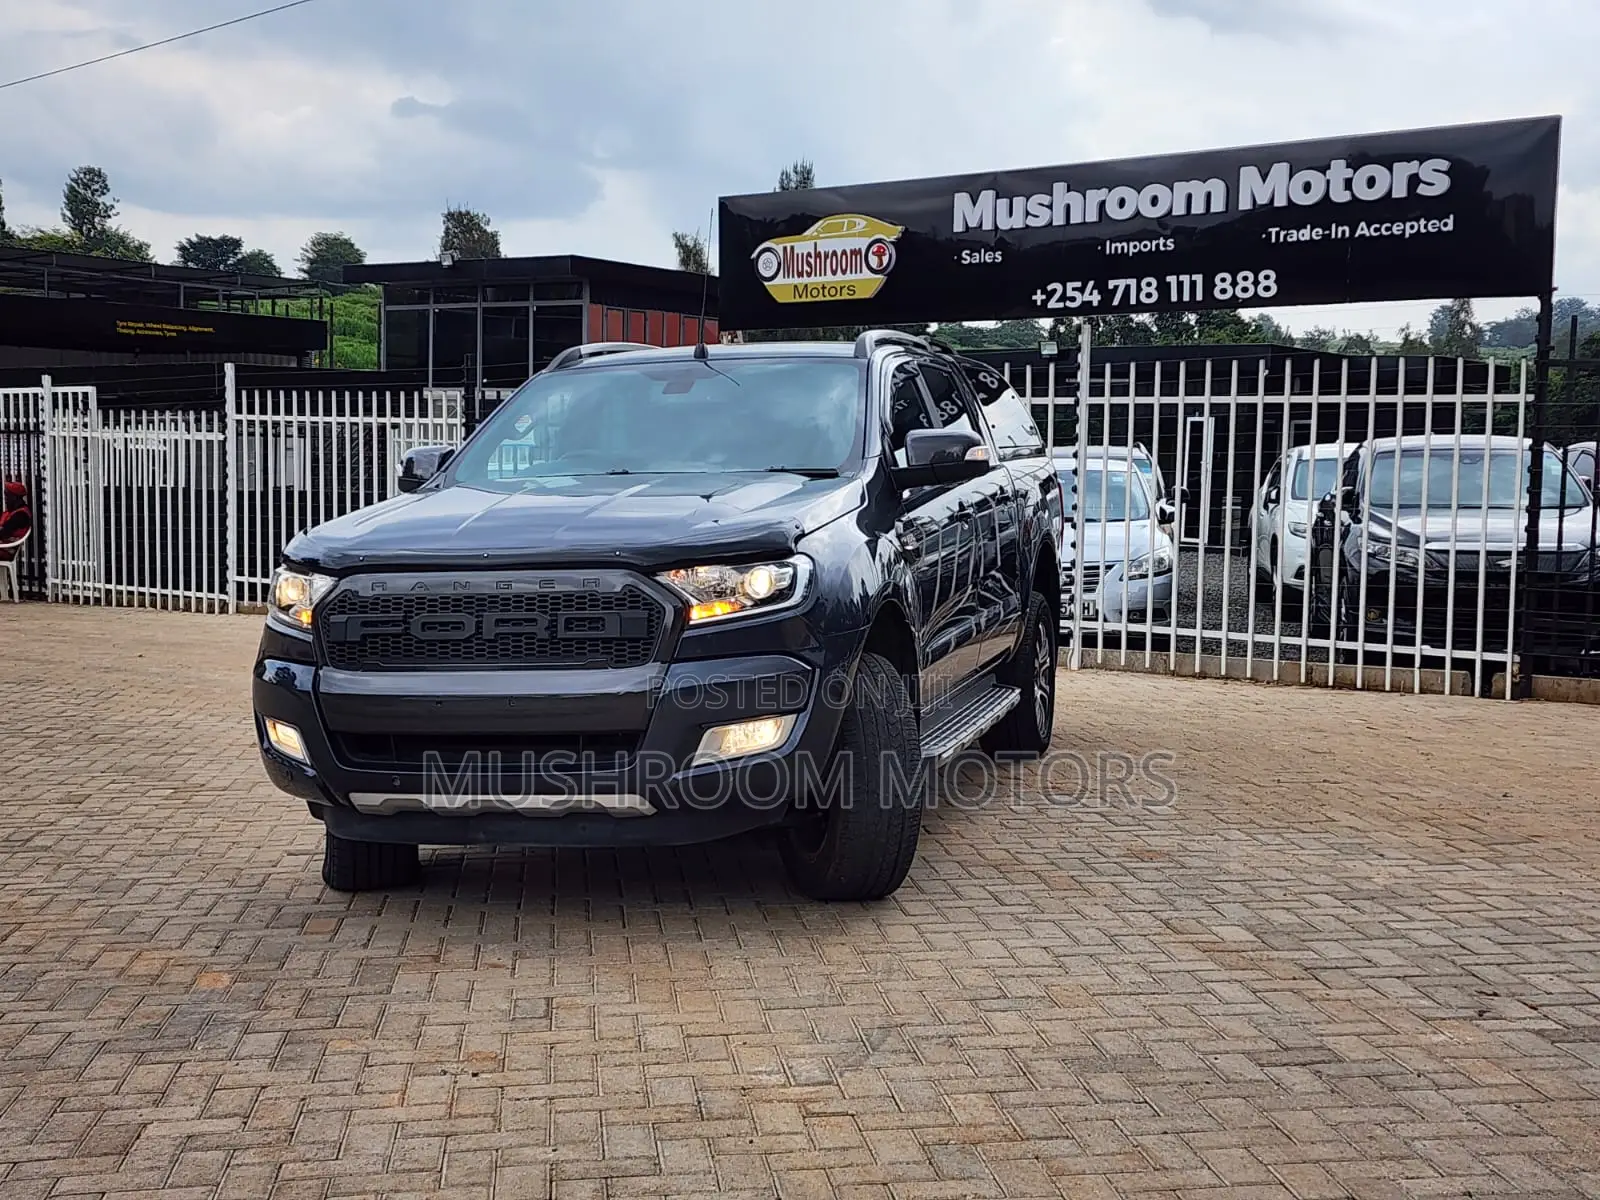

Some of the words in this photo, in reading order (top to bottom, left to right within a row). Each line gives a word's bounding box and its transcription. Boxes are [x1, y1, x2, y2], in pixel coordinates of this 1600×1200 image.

[953, 177, 1226, 233] Mushroom
[1238, 157, 1452, 211] Motors
[1268, 226, 1350, 244] Trade-In
[1354, 214, 1455, 239] Accepted
[961, 248, 1002, 265] Sales
[1105, 236, 1175, 257] Imports
[782, 244, 864, 281] Mushroom
[793, 282, 857, 300] Motors
[1031, 281, 1101, 309] +254
[1108, 277, 1159, 306] 718
[1166, 274, 1204, 302] 111
[1213, 270, 1278, 300] 888
[371, 578, 600, 592] RANGER
[347, 611, 622, 642] FORD
